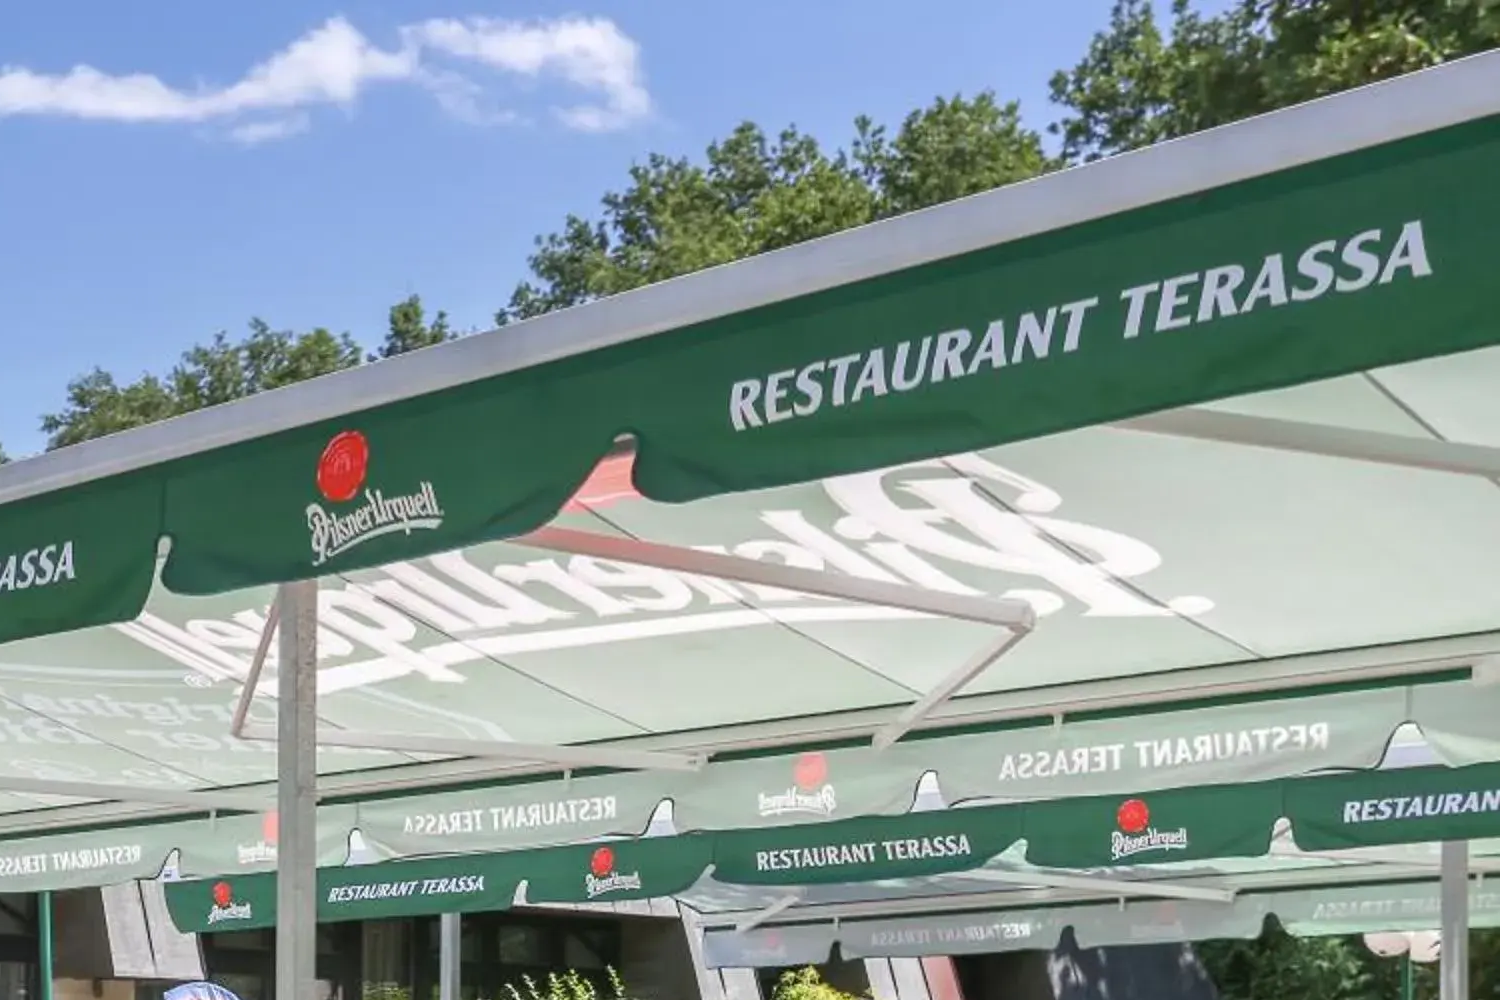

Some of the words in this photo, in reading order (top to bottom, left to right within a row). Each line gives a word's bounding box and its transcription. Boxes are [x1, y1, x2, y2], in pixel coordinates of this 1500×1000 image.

[728, 297, 1100, 431] RESTAURANT
[1120, 220, 1434, 340] TERASSA
[757, 842, 878, 871] RESTAURANT
[882, 834, 972, 861] TERASSA
[328, 881, 419, 904] RESTAURANT
[420, 875, 485, 895] TERASSA
